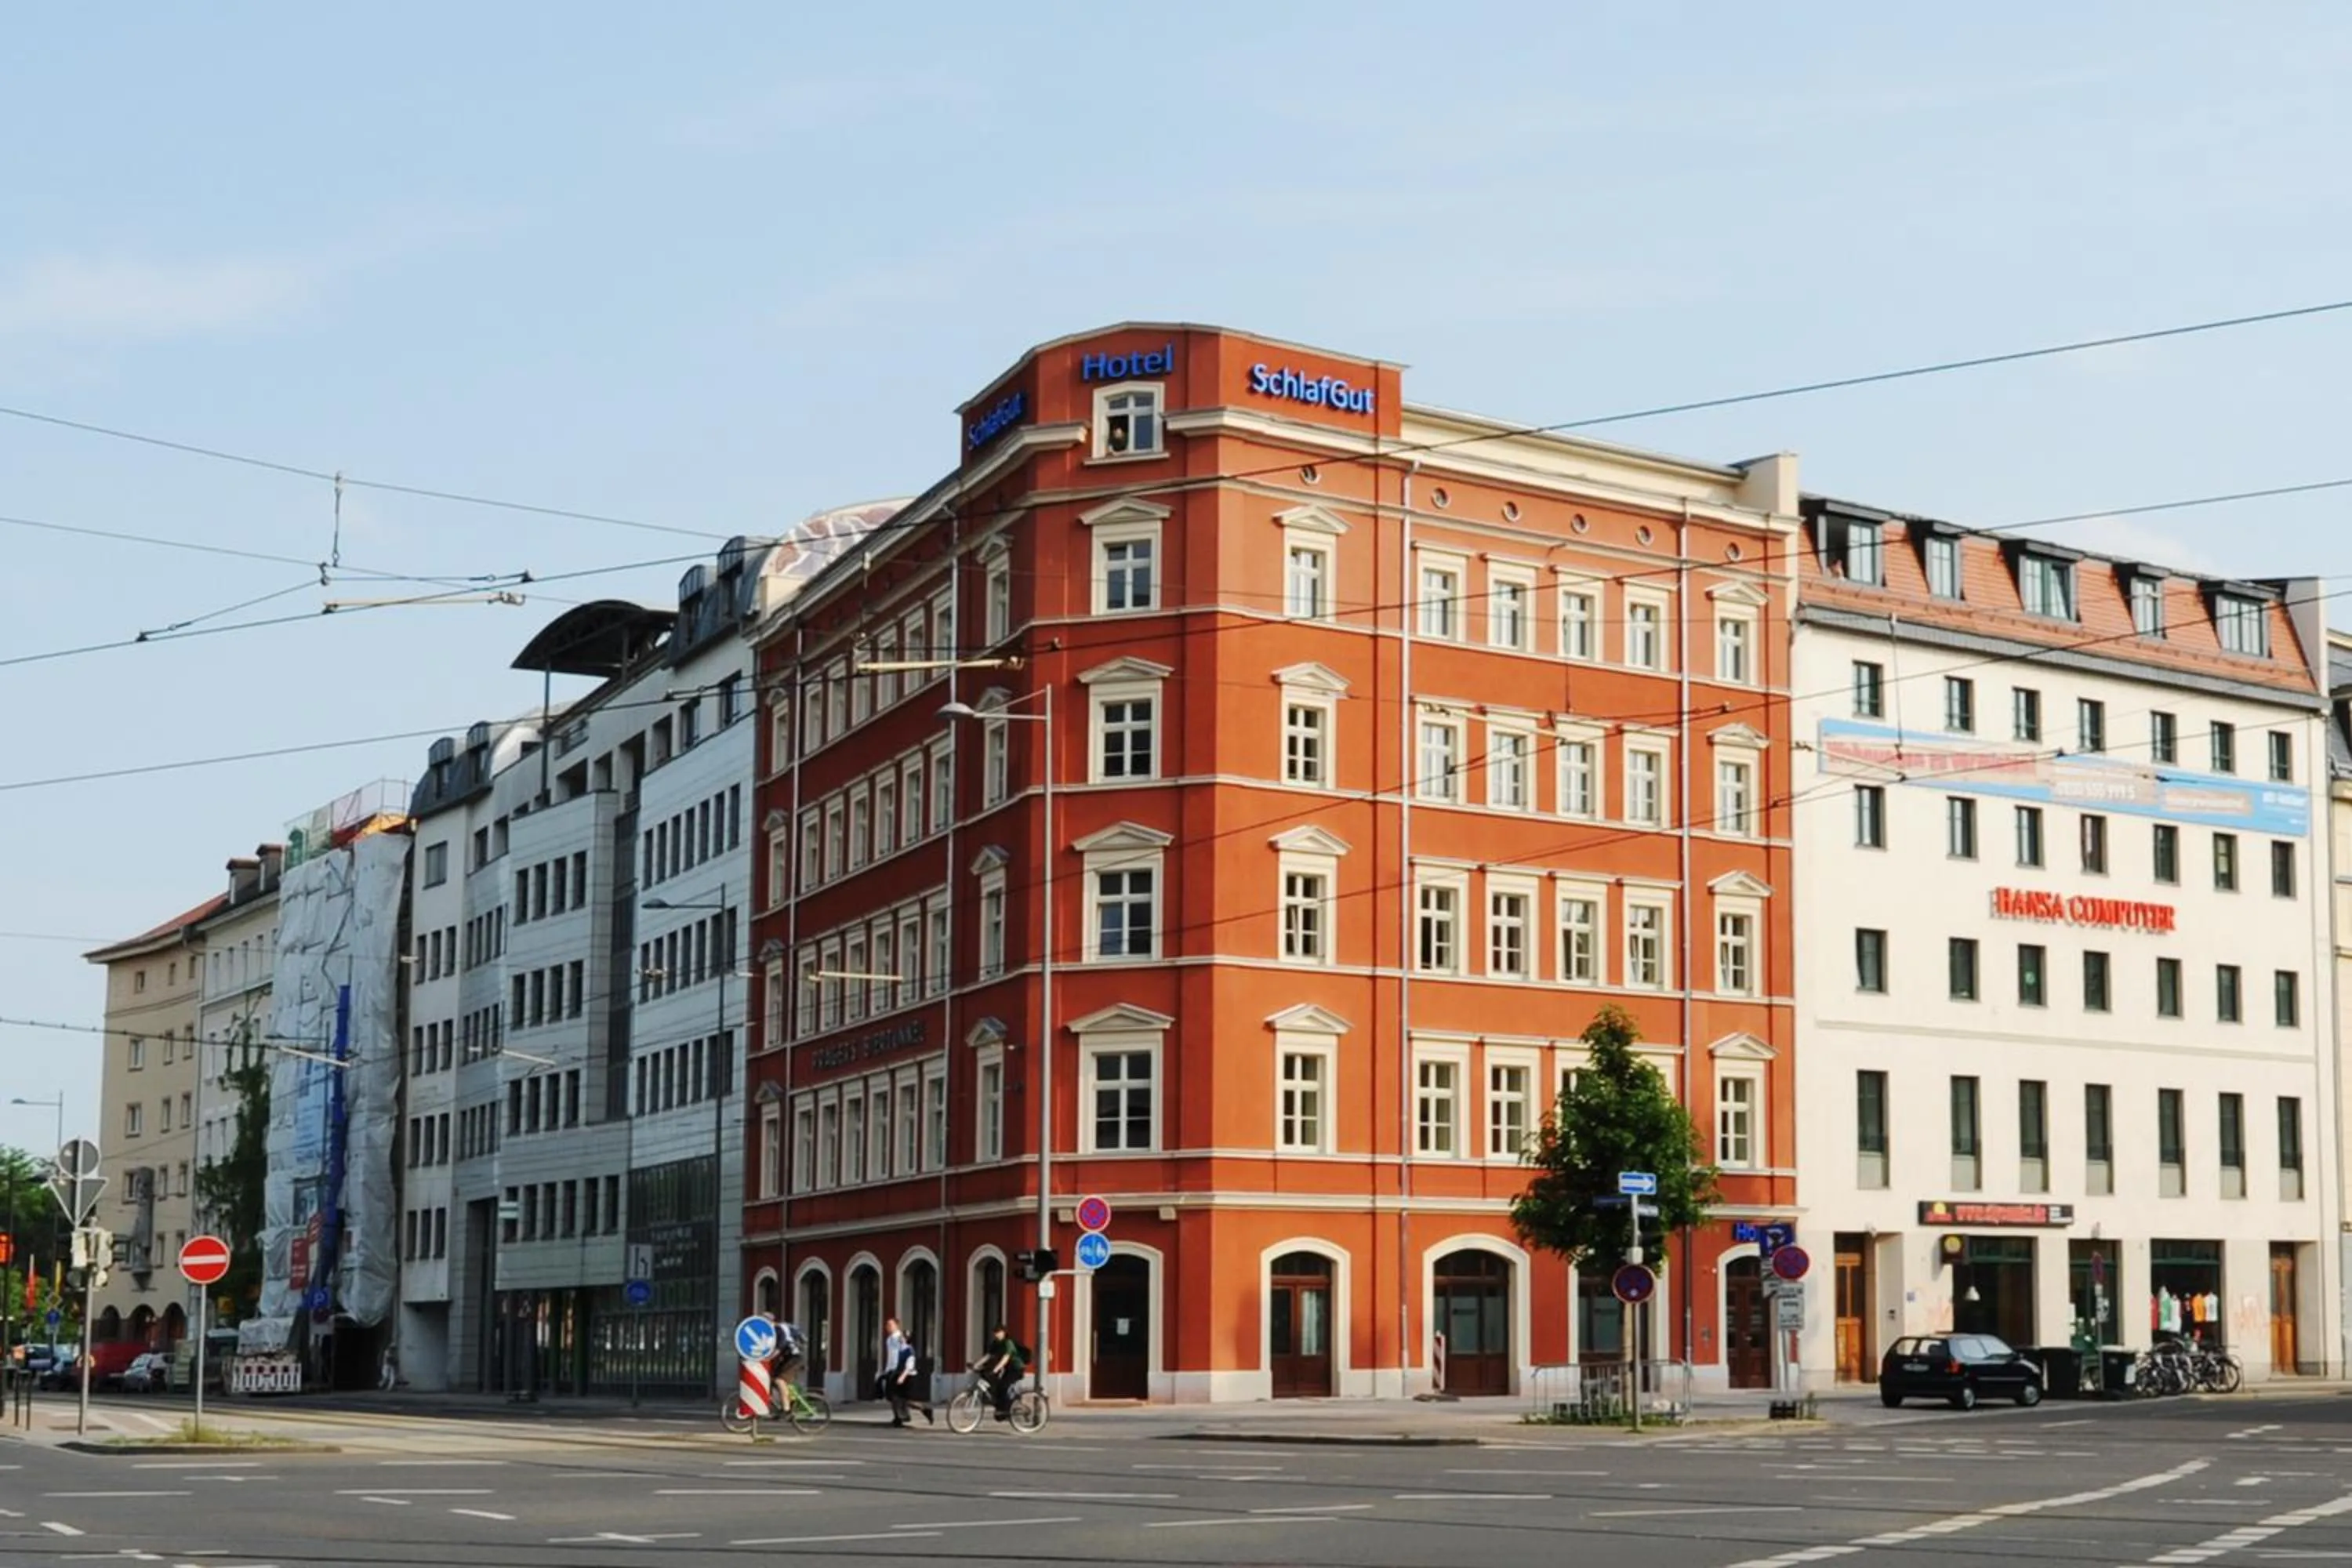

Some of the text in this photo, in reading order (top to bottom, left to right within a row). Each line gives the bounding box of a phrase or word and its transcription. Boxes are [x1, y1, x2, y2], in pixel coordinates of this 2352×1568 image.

[1083, 343, 1173, 380] Hotel
[1252, 363, 1375, 415] SchlafGut
[1995, 887, 2176, 931] HANSA COMPUTER
